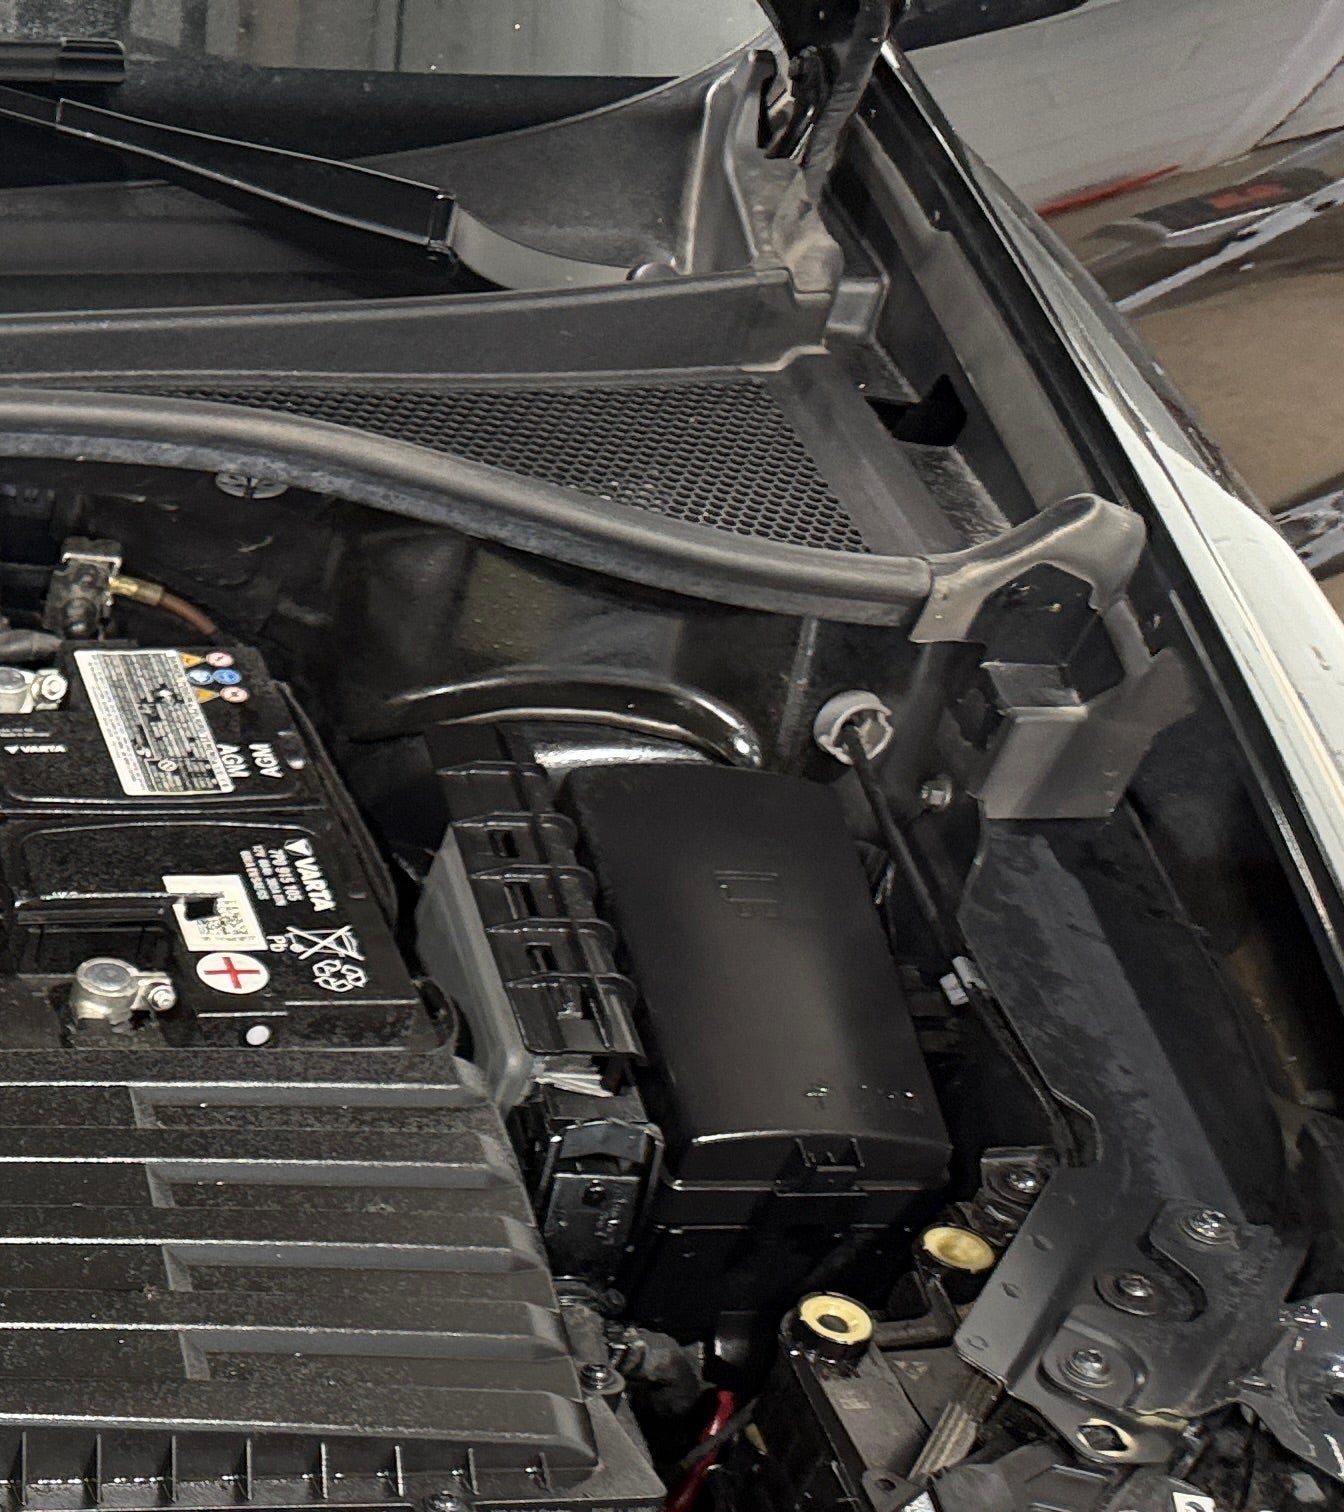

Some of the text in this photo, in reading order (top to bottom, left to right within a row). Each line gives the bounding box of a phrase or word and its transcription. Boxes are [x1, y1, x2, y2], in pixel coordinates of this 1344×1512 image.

[216, 744, 250, 778] AGM
[248, 743, 285, 778] AGM
[294, 857, 336, 912] VARTA
[266, 935, 289, 953] Pb
